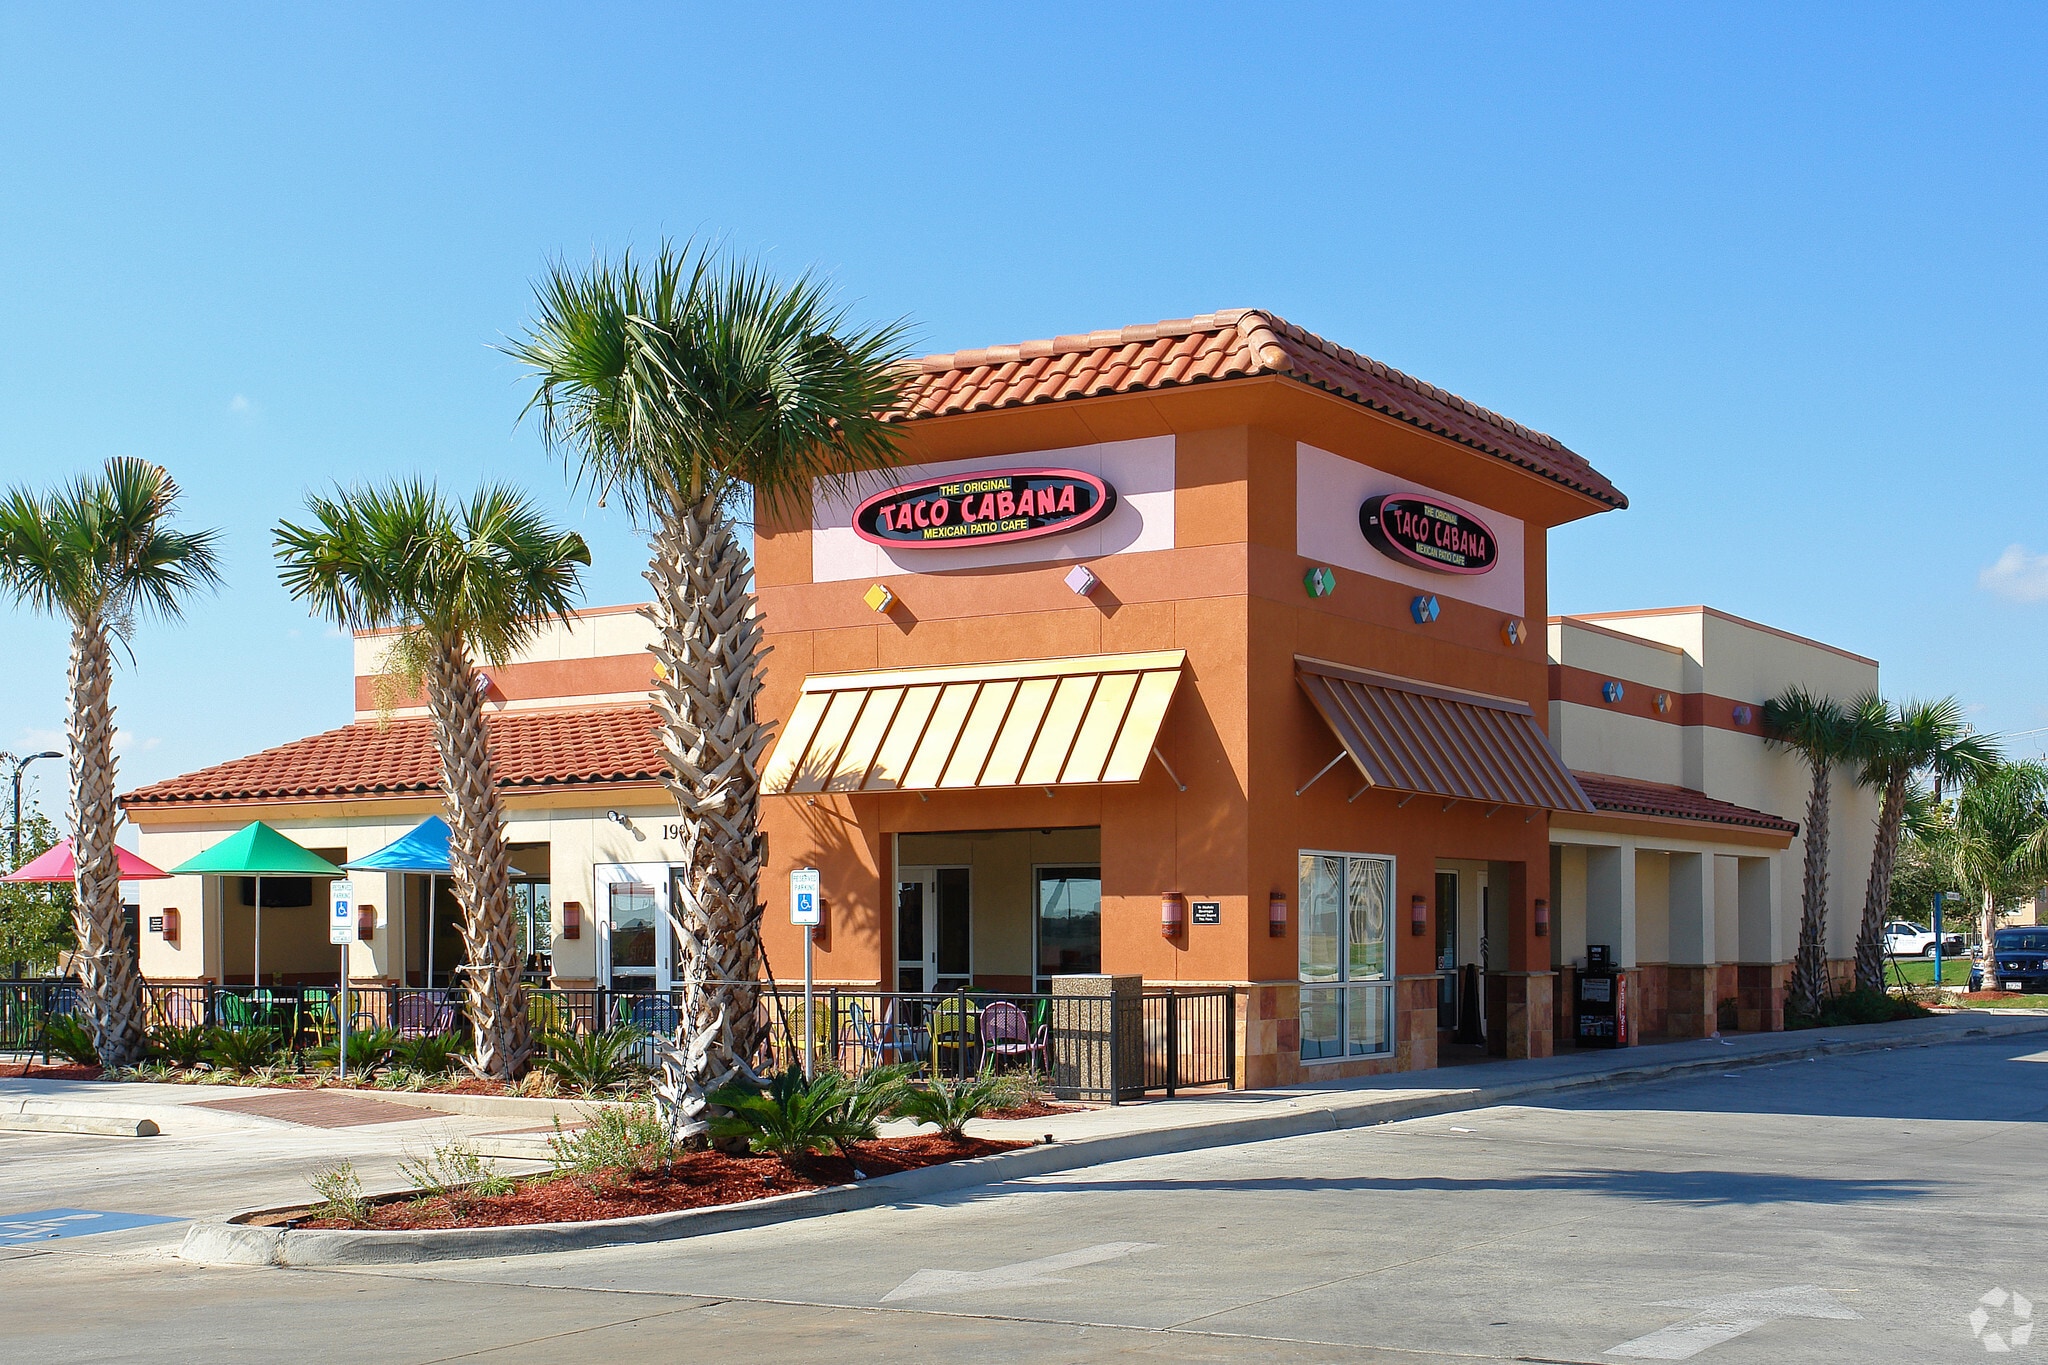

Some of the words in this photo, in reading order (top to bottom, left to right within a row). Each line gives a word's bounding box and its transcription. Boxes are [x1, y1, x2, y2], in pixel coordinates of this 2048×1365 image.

[940, 485, 960, 497] THE
[963, 478, 1011, 494] ORIGINAL
[880, 497, 950, 531] TACO
[960, 484, 1076, 523] CABANA
[1424, 505, 1435, 518] THE
[1435, 508, 1458, 525] ORIGINAL
[923, 524, 967, 539] MEXICAN
[970, 521, 998, 535] PATIO
[1001, 518, 1028, 532] CAFE
[1394, 509, 1429, 543] TACO
[1434, 521, 1487, 561] CABANA
[1415, 543, 1438, 558] MEXICAN
[1439, 549, 1452, 562] PATIO
[1452, 553, 1466, 566] CAFE
